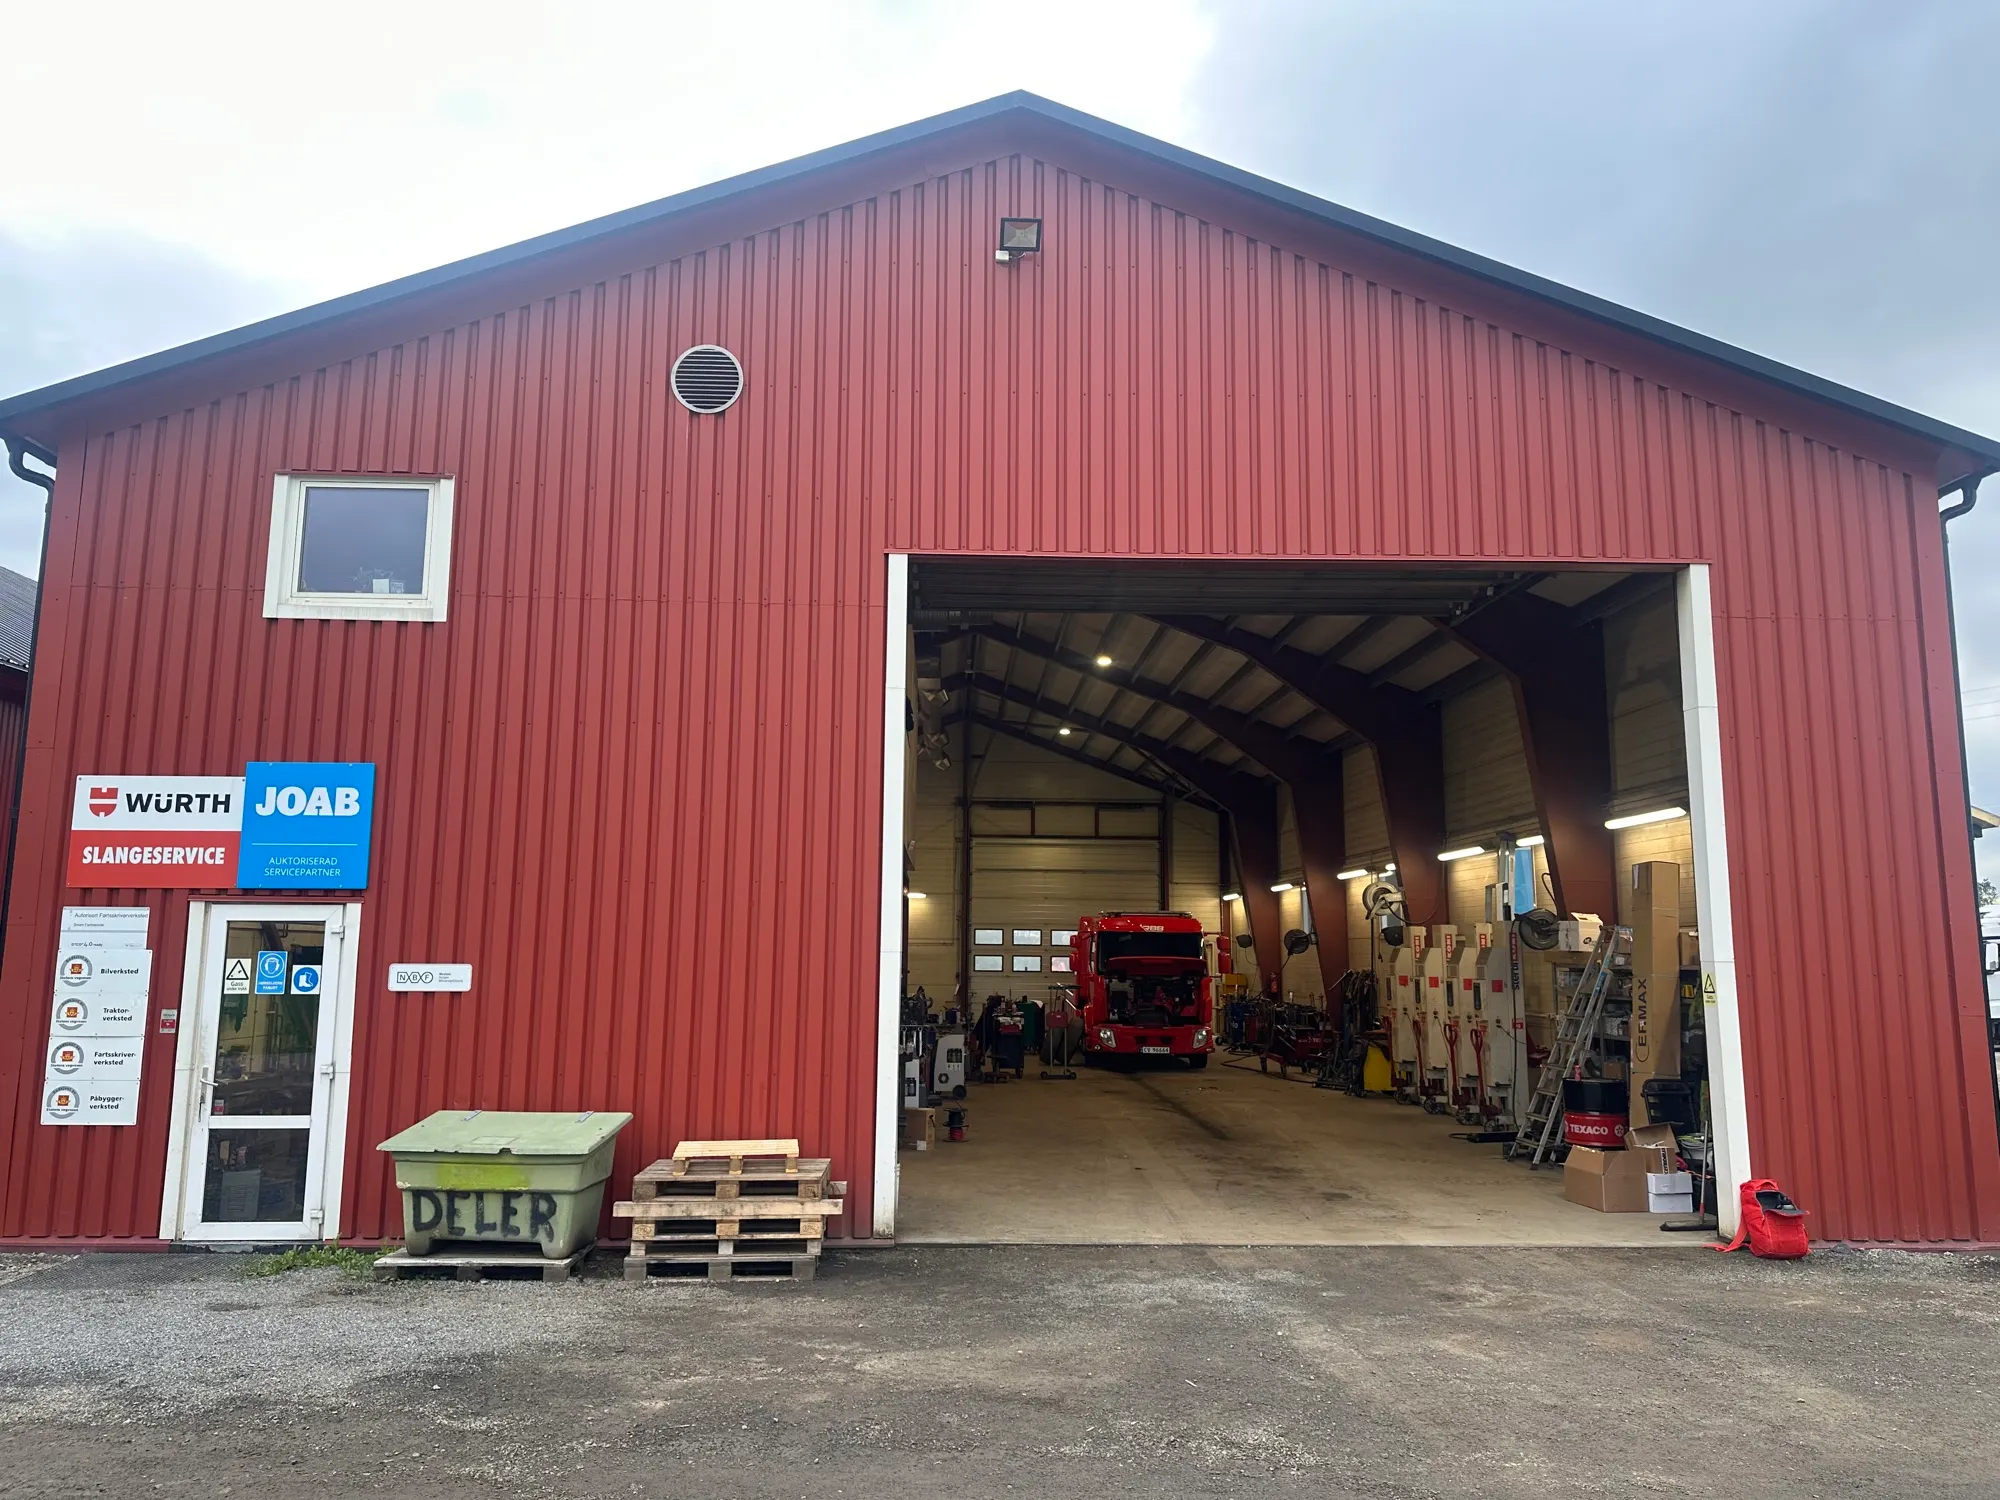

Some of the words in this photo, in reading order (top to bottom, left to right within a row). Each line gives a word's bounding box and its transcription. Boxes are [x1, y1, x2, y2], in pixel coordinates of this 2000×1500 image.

[126, 793, 231, 814] WÜRTH
[255, 786, 361, 817] JOAB
[82, 846, 226, 865] SLANGESERVICE
[268, 857, 338, 866] AUKTORISERAD
[264, 868, 341, 877] SERVICEPARTNER
[89, 1095, 125, 1103] Påbygger-
[1570, 1123, 1609, 1136] TEXACO
[411, 1190, 557, 1243] DELER
